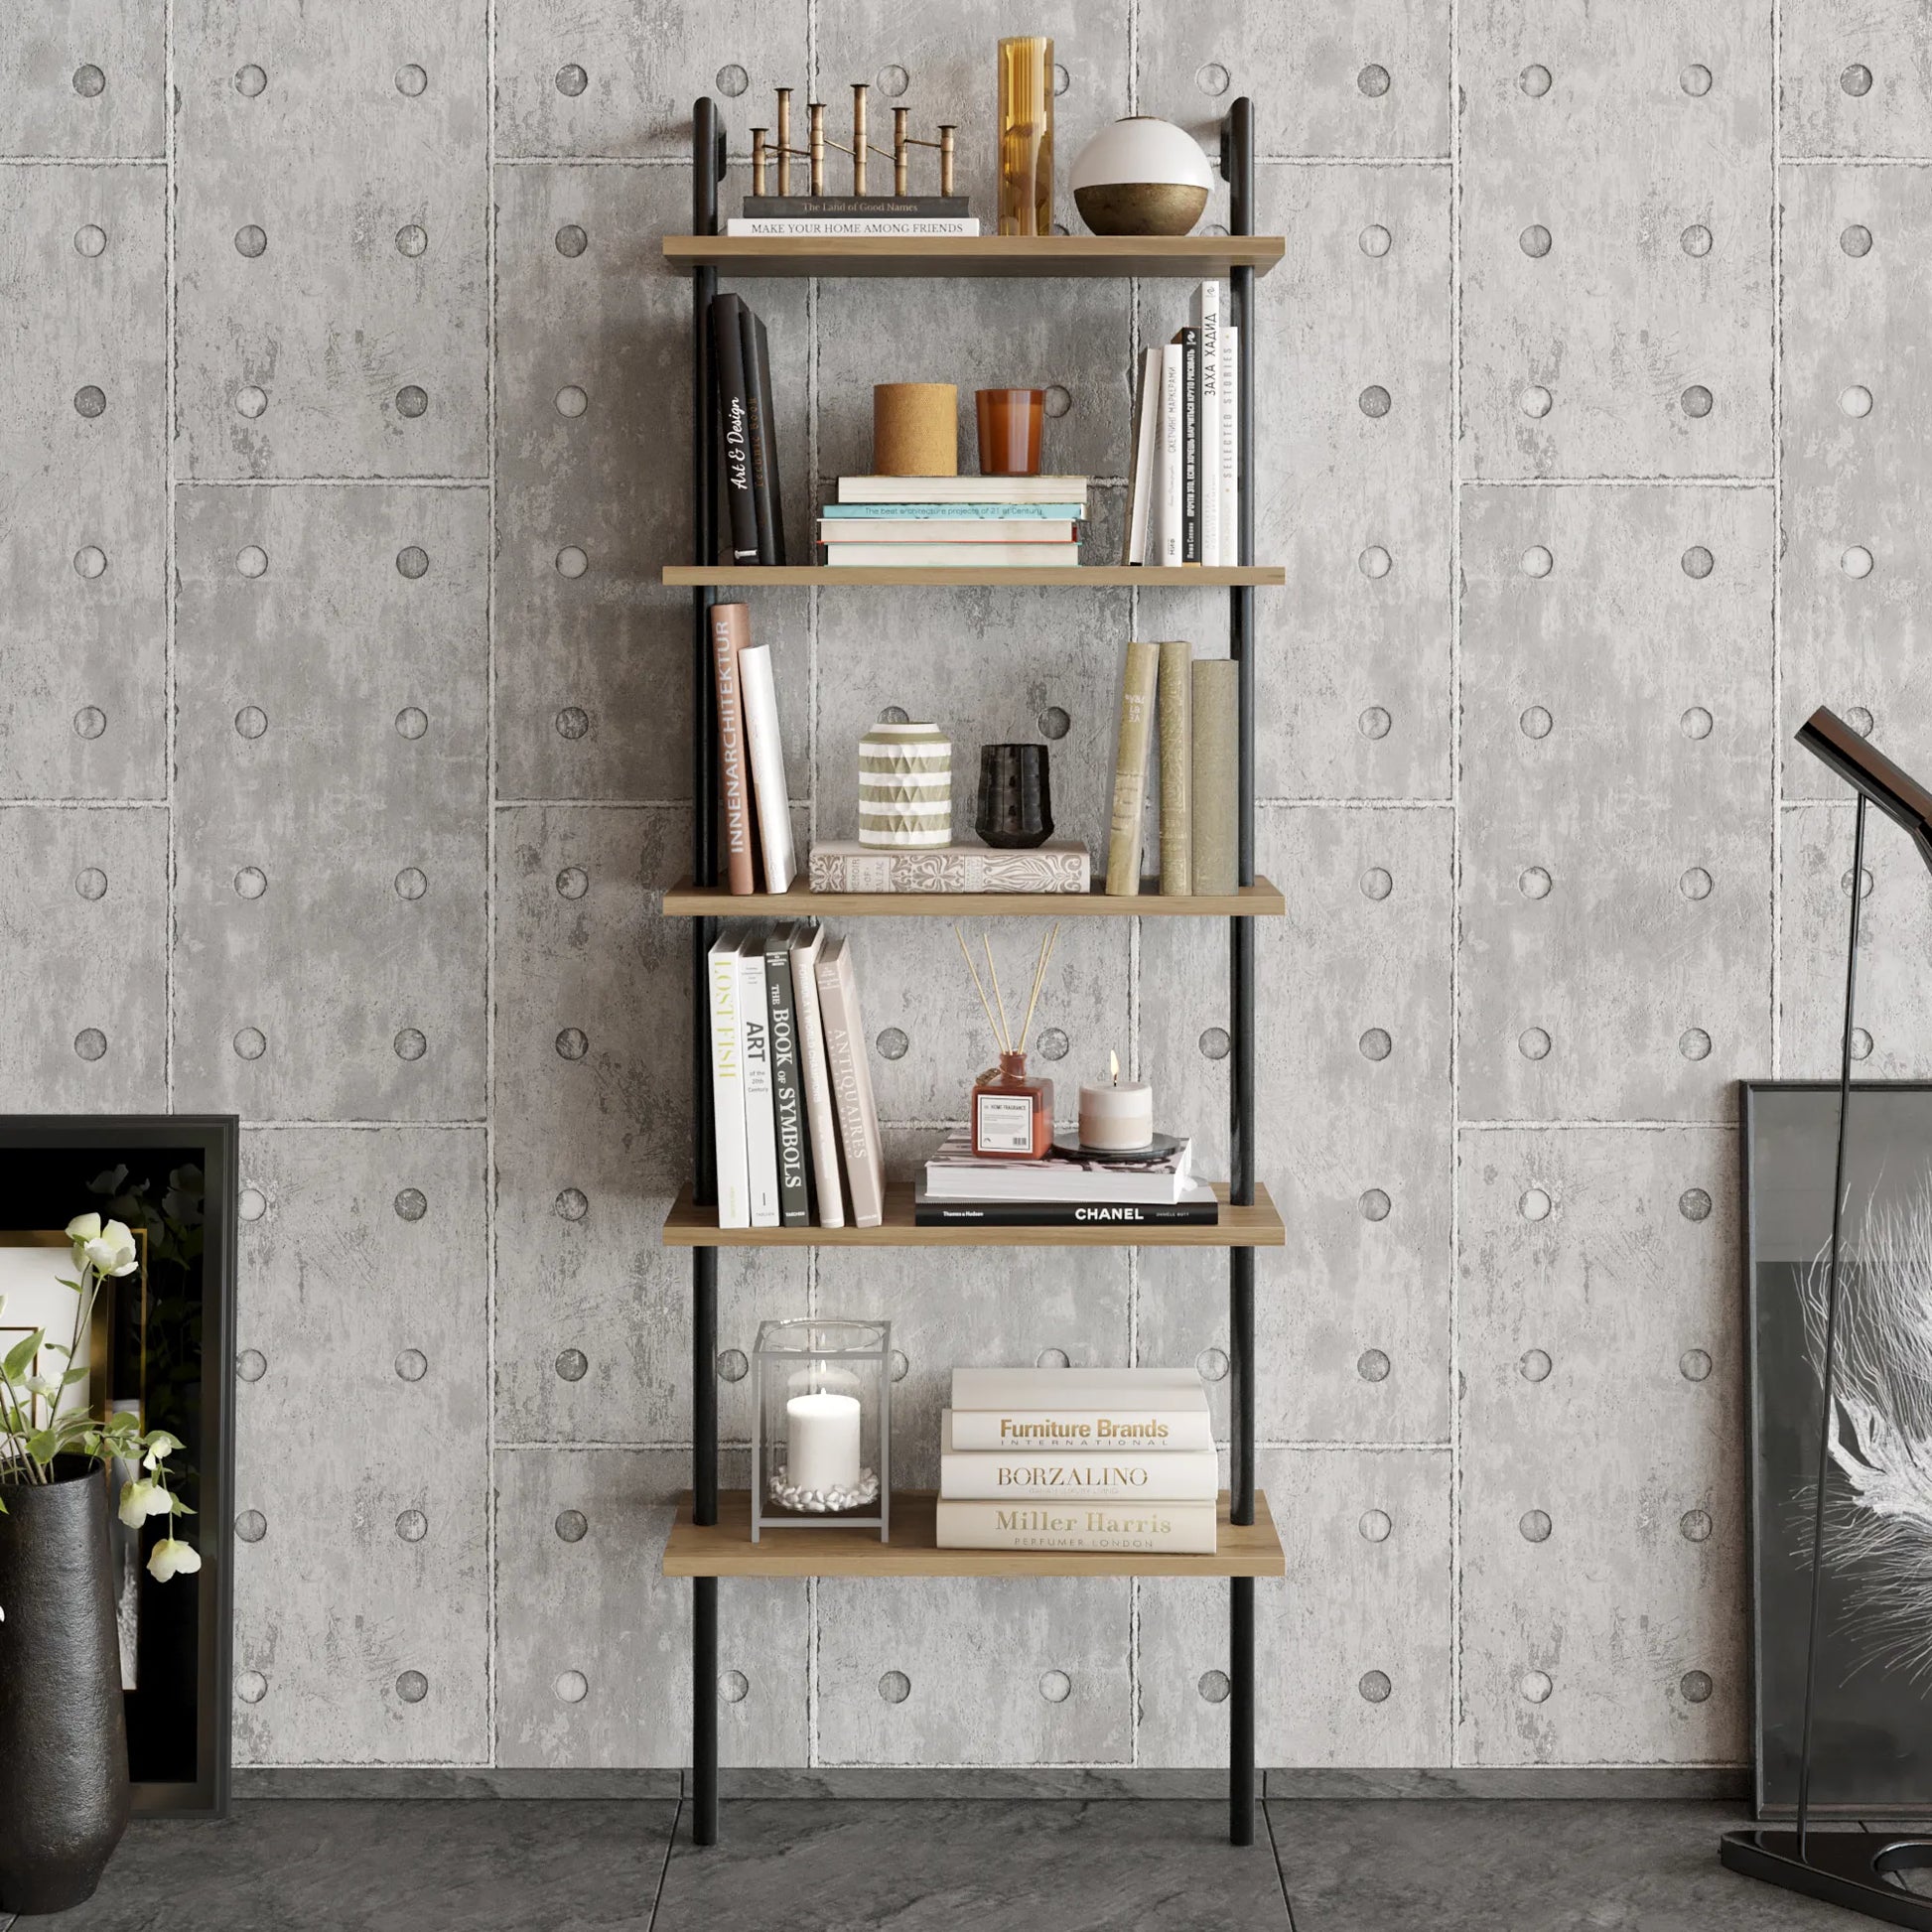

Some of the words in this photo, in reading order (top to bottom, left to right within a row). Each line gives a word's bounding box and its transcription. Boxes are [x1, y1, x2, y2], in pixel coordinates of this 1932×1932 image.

[803, 202, 820, 211] The
[822, 202, 845, 211] Land
[848, 202, 858, 211] of
[859, 202, 885, 211] Good
[887, 202, 918, 211] Names
[752, 223, 785, 233] MAKE
[788, 223, 821, 233] YOUR
[824, 223, 861, 233] HOME
[864, 223, 910, 233] AMONG
[912, 223, 963, 233] FRIENDS
[1204, 313, 1217, 357] ХАДИД
[1168, 366, 1176, 413] МАРКЕРАМИ
[1204, 363, 1216, 396] ЗАХА
[1223, 347, 1232, 406] STORIES
[727, 397, 746, 445] Design
[728, 449, 746, 462] &
[1223, 413, 1232, 479] SELECTED
[730, 462, 748, 489] Art
[716, 621, 745, 854] INNENARCHITEKTUR
[771, 984, 780, 1005] THE
[746, 1022, 765, 1062] ART
[772, 1009, 793, 1067] BOOK
[776, 1071, 786, 1084] OF
[835, 1030, 867, 1160] ANTIQUAIRES
[778, 1087, 802, 1188] SYMBOLS
[1074, 1207, 1145, 1220] CHANEL
[1001, 1419, 1091, 1438] Furniture
[1097, 1419, 1169, 1438] Brands
[997, 1467, 1149, 1486] BORZALINO
[995, 1510, 1077, 1532] Miller
[1085, 1512, 1172, 1534] Harris
[1015, 1537, 1084, 1547] PERFUMER
[1092, 1539, 1154, 1548] LONDON
